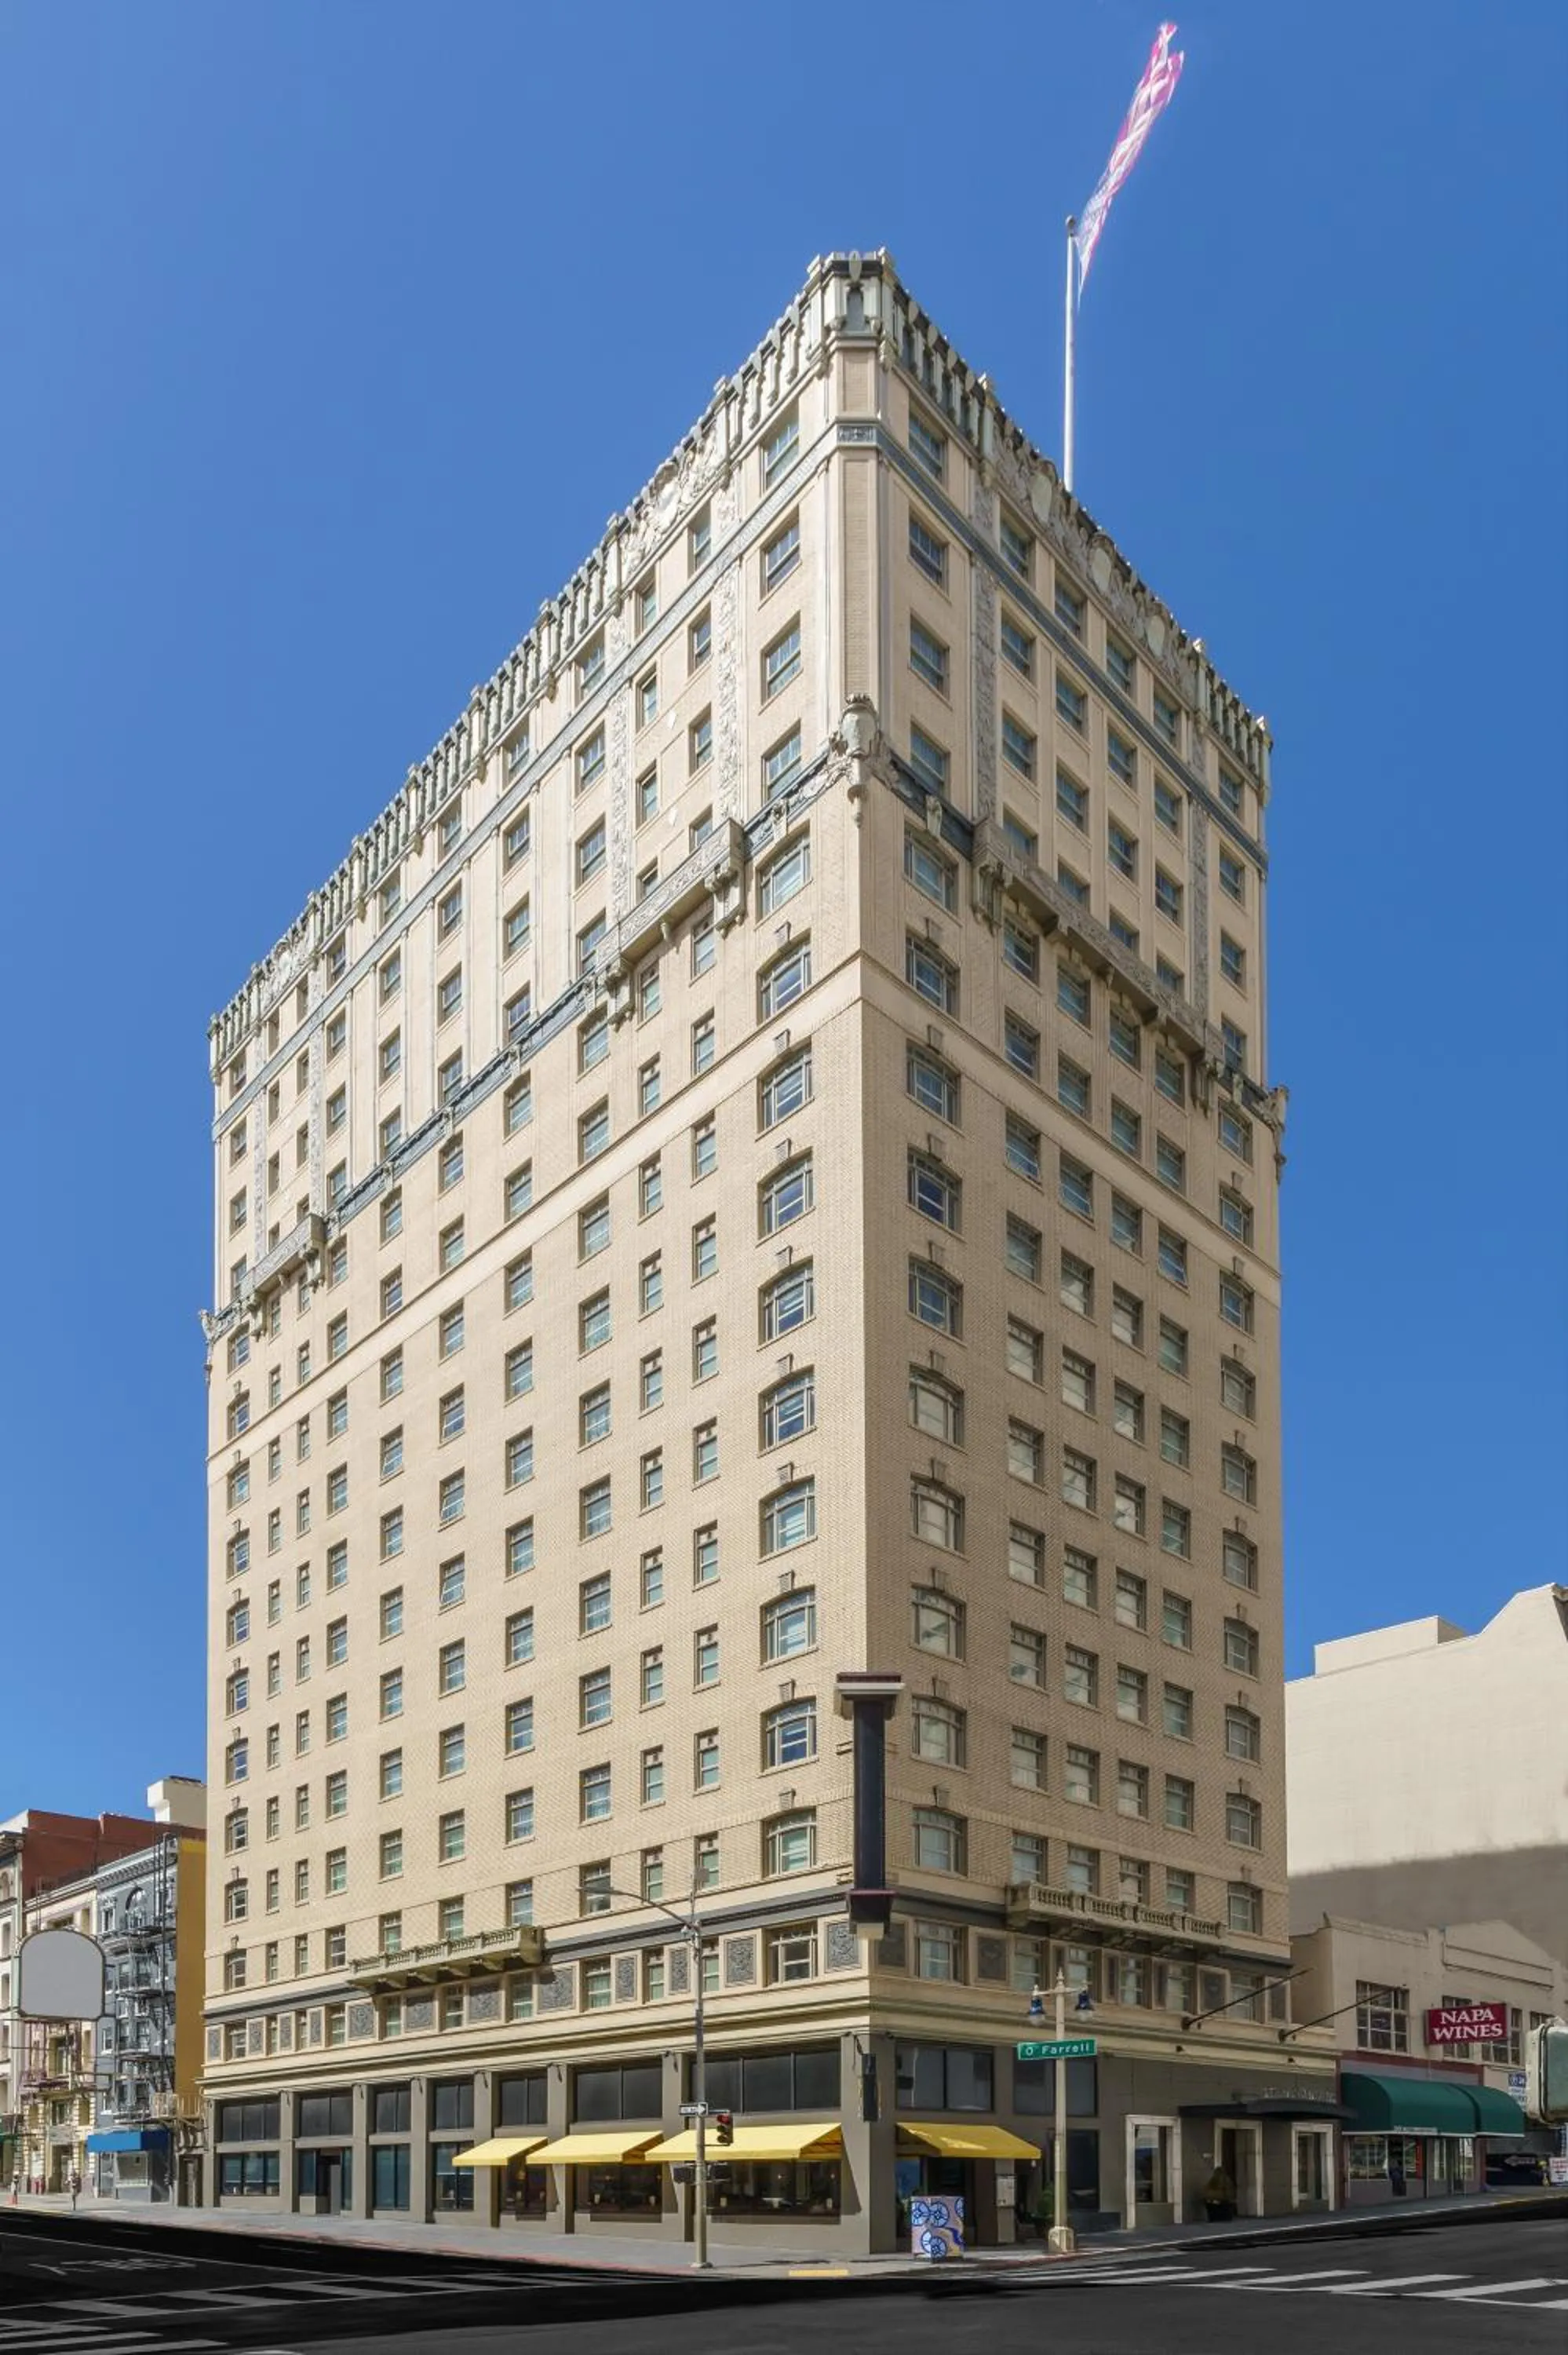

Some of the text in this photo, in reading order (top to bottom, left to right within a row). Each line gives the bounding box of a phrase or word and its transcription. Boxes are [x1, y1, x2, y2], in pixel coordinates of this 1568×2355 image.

[1440, 2008, 1495, 2025] NAPA
[1433, 2023, 1503, 2041] WINES
[1041, 2043, 1089, 2054] Farrell
